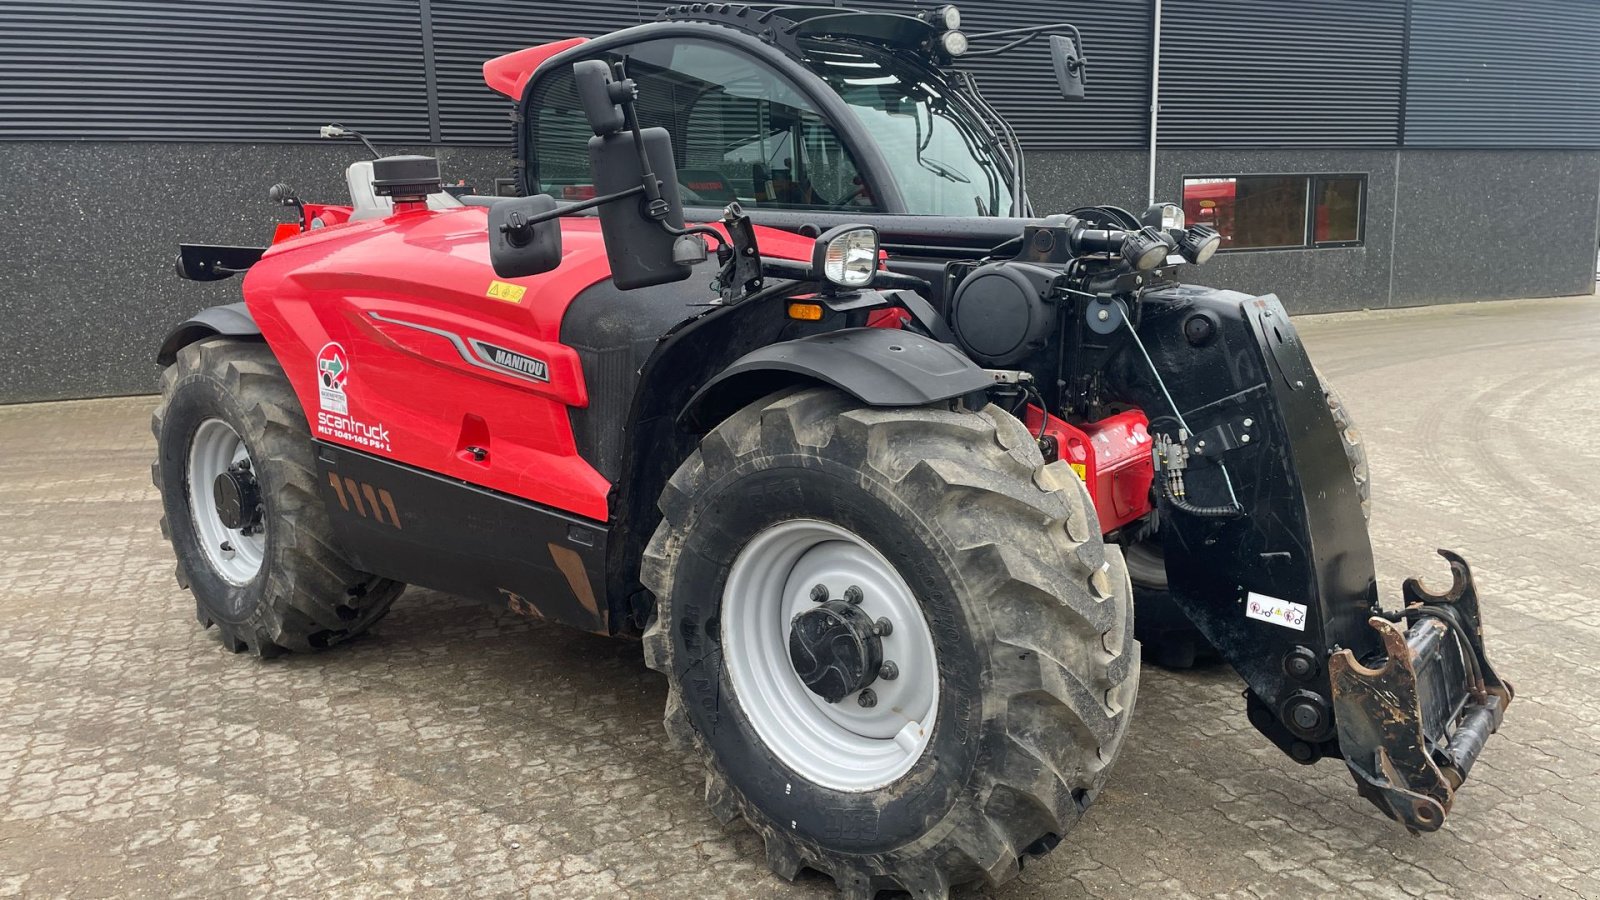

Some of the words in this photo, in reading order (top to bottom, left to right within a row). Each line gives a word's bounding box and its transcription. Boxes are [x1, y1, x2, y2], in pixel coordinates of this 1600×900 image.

[495, 349, 543, 376] MANITOU
[317, 411, 390, 443] scantruck
[317, 425, 333, 436] MLT
[333, 429, 369, 445] 1041-145
[386, 444, 392, 452] L
